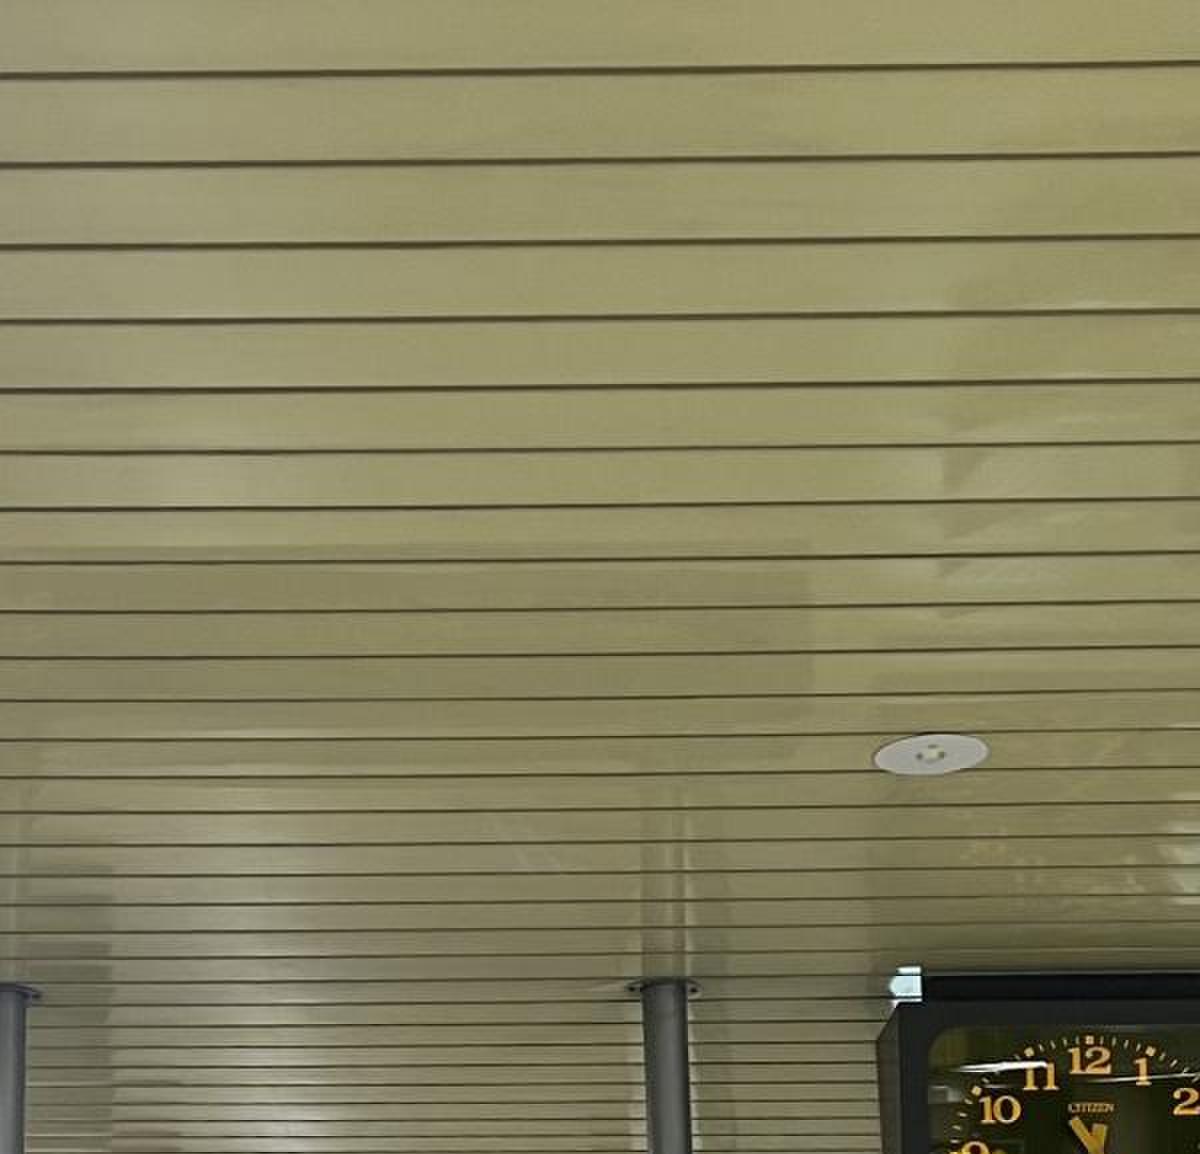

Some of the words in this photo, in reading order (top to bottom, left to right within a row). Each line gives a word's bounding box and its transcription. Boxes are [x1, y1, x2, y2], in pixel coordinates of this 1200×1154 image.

[1068, 1047, 1112, 1074] 12
[1135, 1058, 1152, 1086] 1
[1023, 1063, 1059, 1090] 11
[979, 1096, 1021, 1124] 10
[1173, 1088, 1200, 1115] 2
